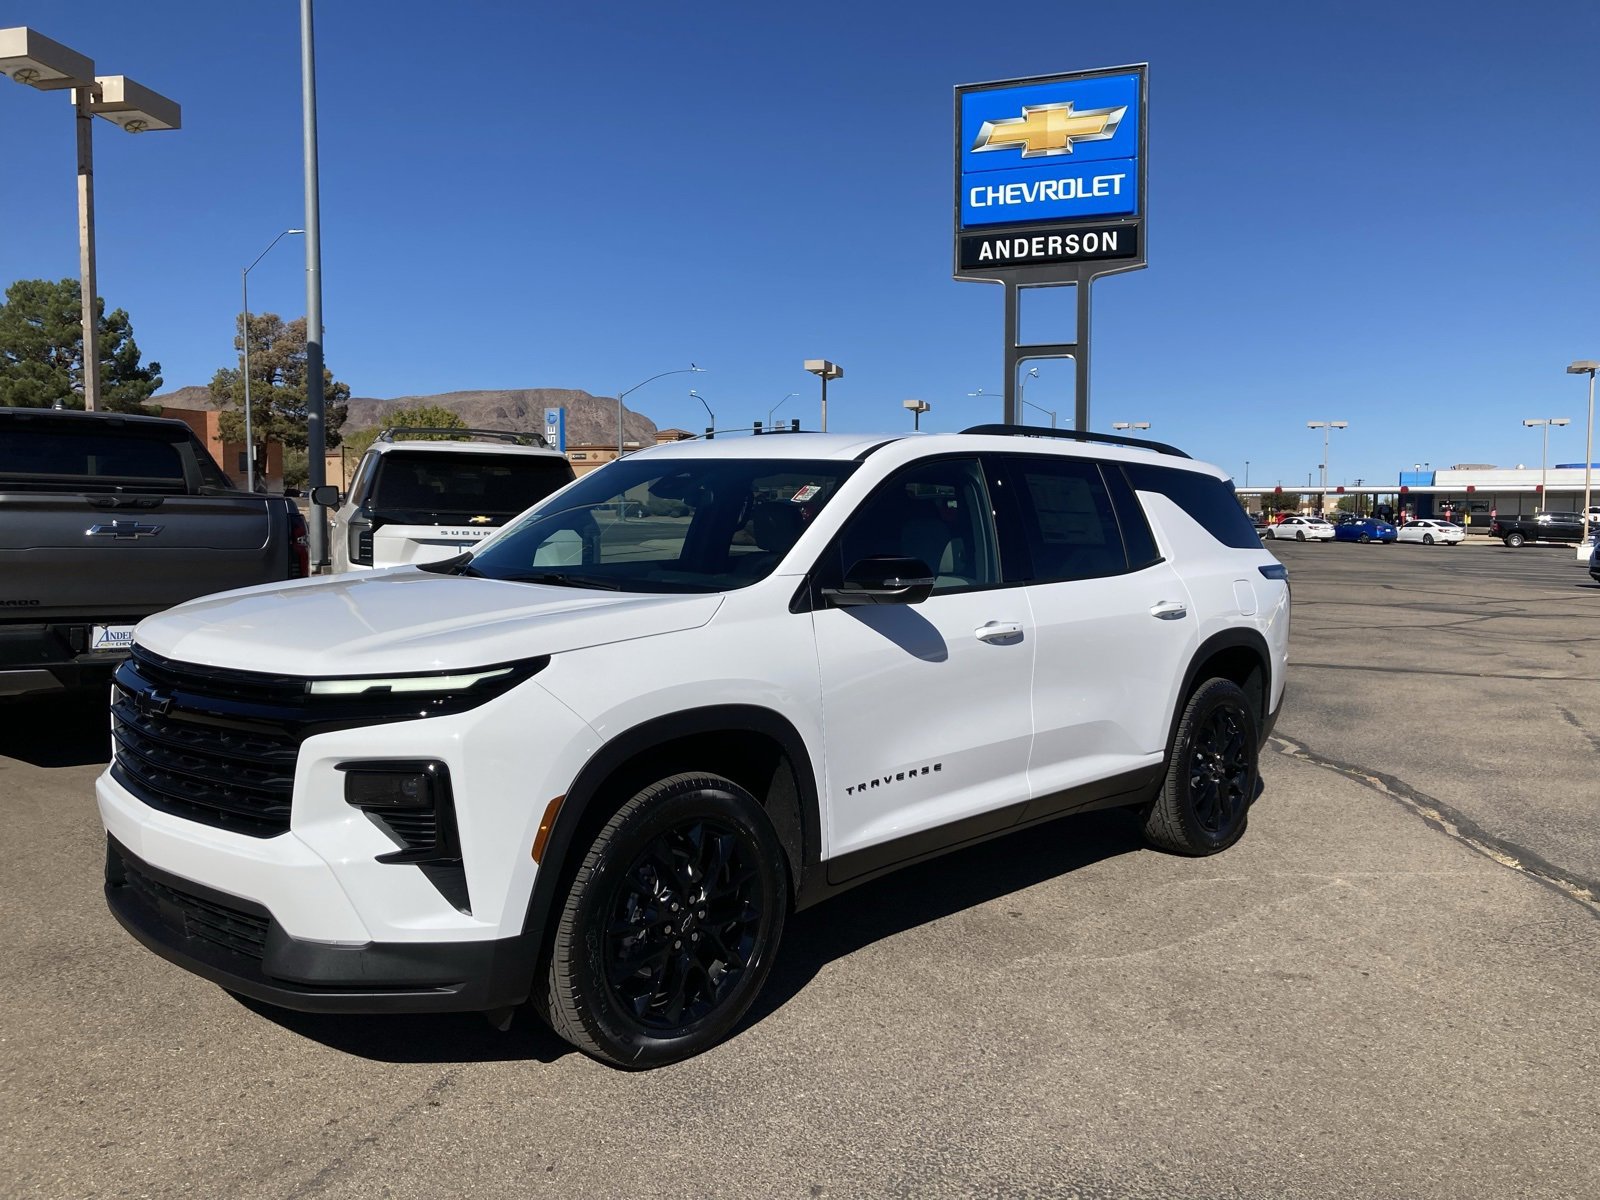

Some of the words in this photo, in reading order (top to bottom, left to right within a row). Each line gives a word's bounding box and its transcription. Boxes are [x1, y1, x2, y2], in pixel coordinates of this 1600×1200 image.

[970, 173, 1126, 208] CHEVROLET
[978, 231, 1118, 261] ANDERSON
[845, 762, 942, 795] TRAVERSE
